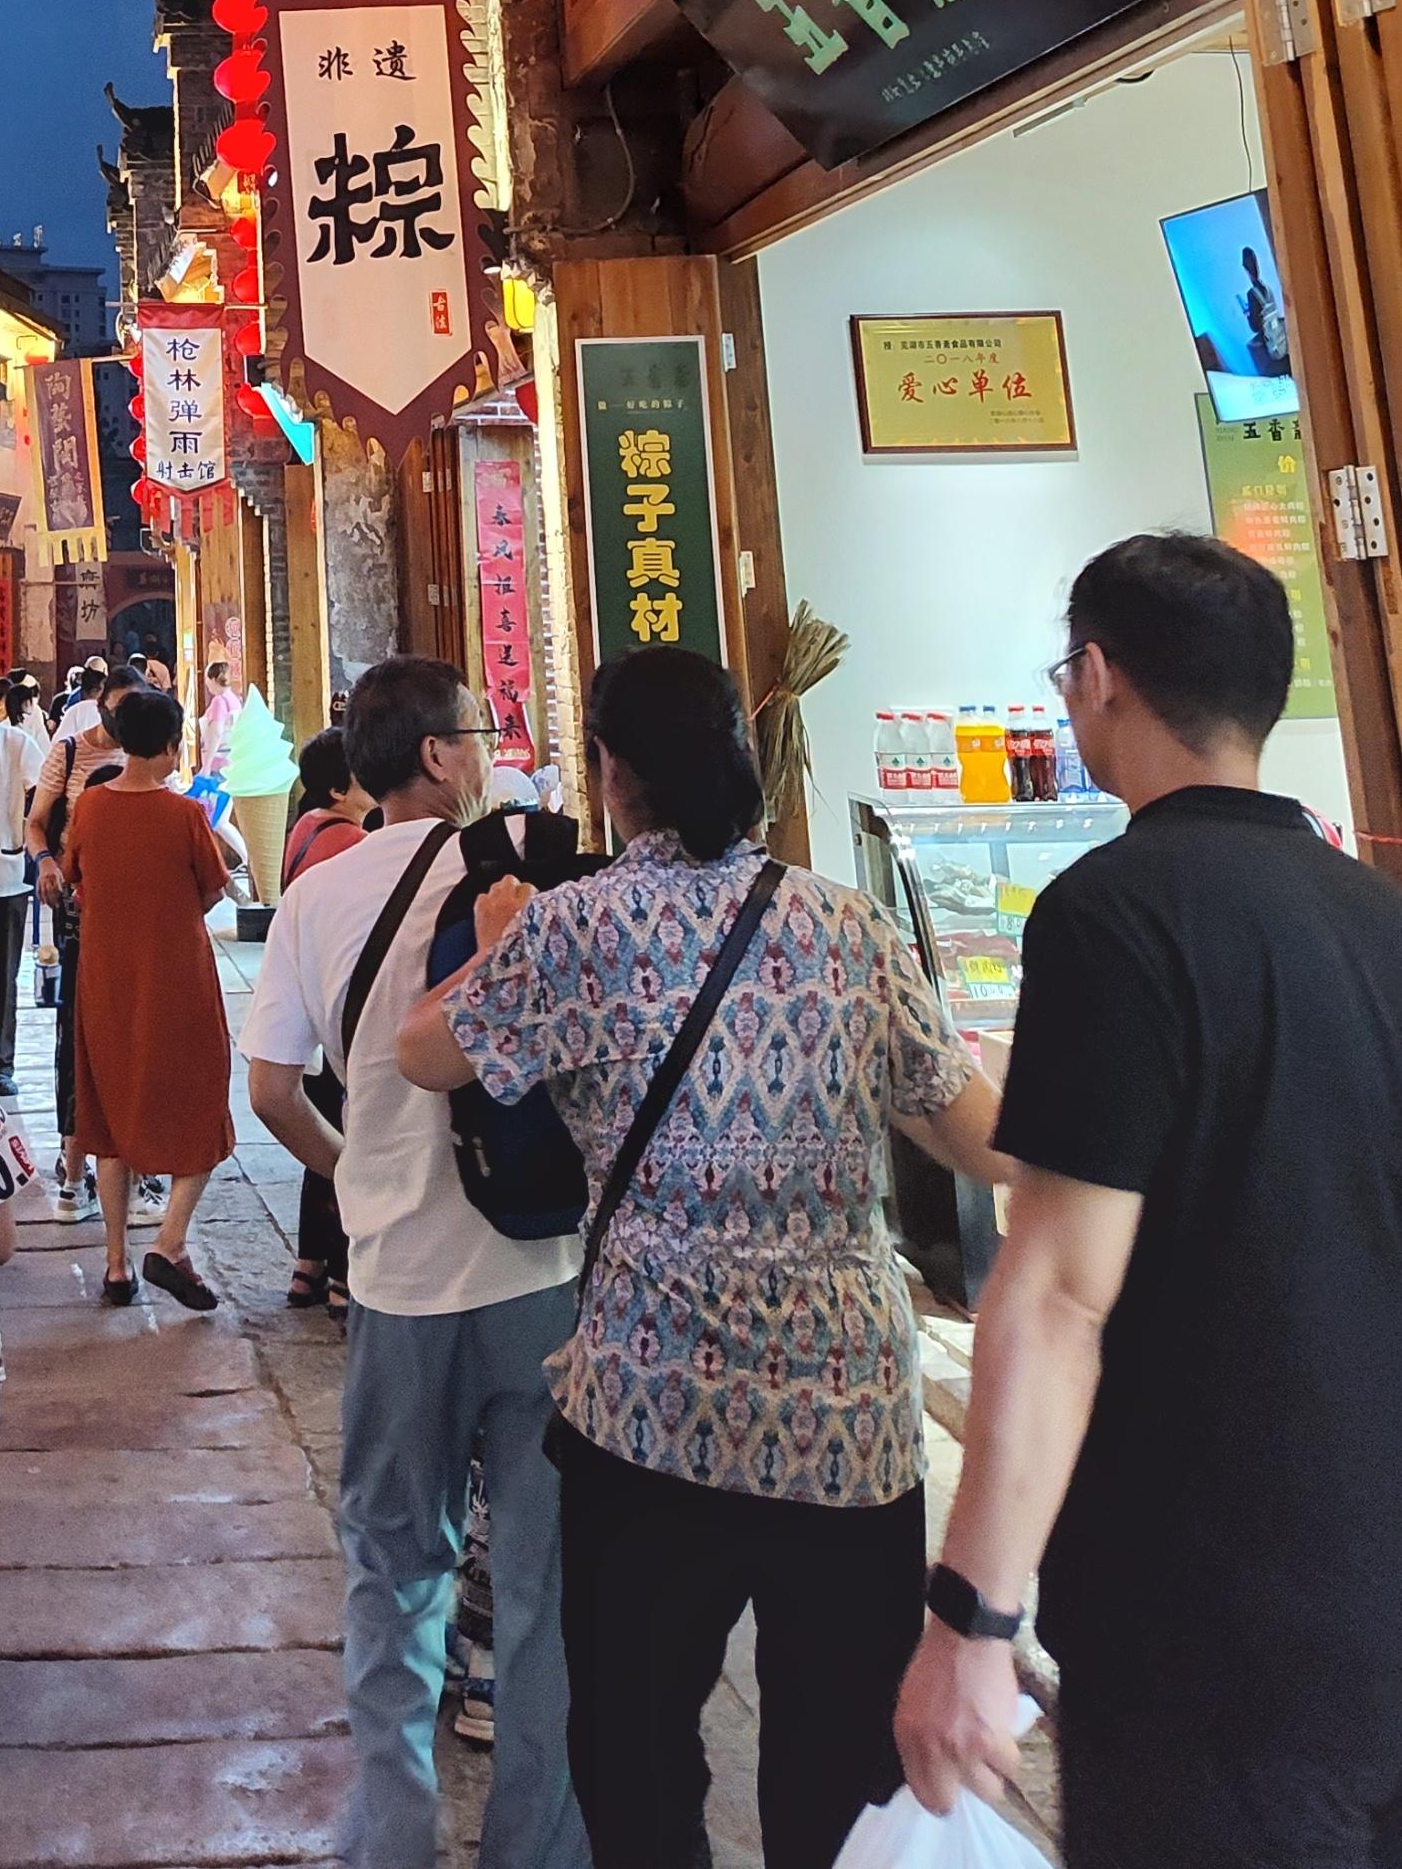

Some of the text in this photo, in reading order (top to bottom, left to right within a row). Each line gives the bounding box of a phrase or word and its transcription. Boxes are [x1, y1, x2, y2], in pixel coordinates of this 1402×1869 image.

[318, 39, 417, 82] 非遗
[306, 125, 456, 266] 粽
[165, 337, 203, 454] 枪林弹雨
[898, 369, 1032, 403] 爱心单位
[156, 460, 216, 481] 射击馆
[618, 429, 684, 643] 粽子真材
